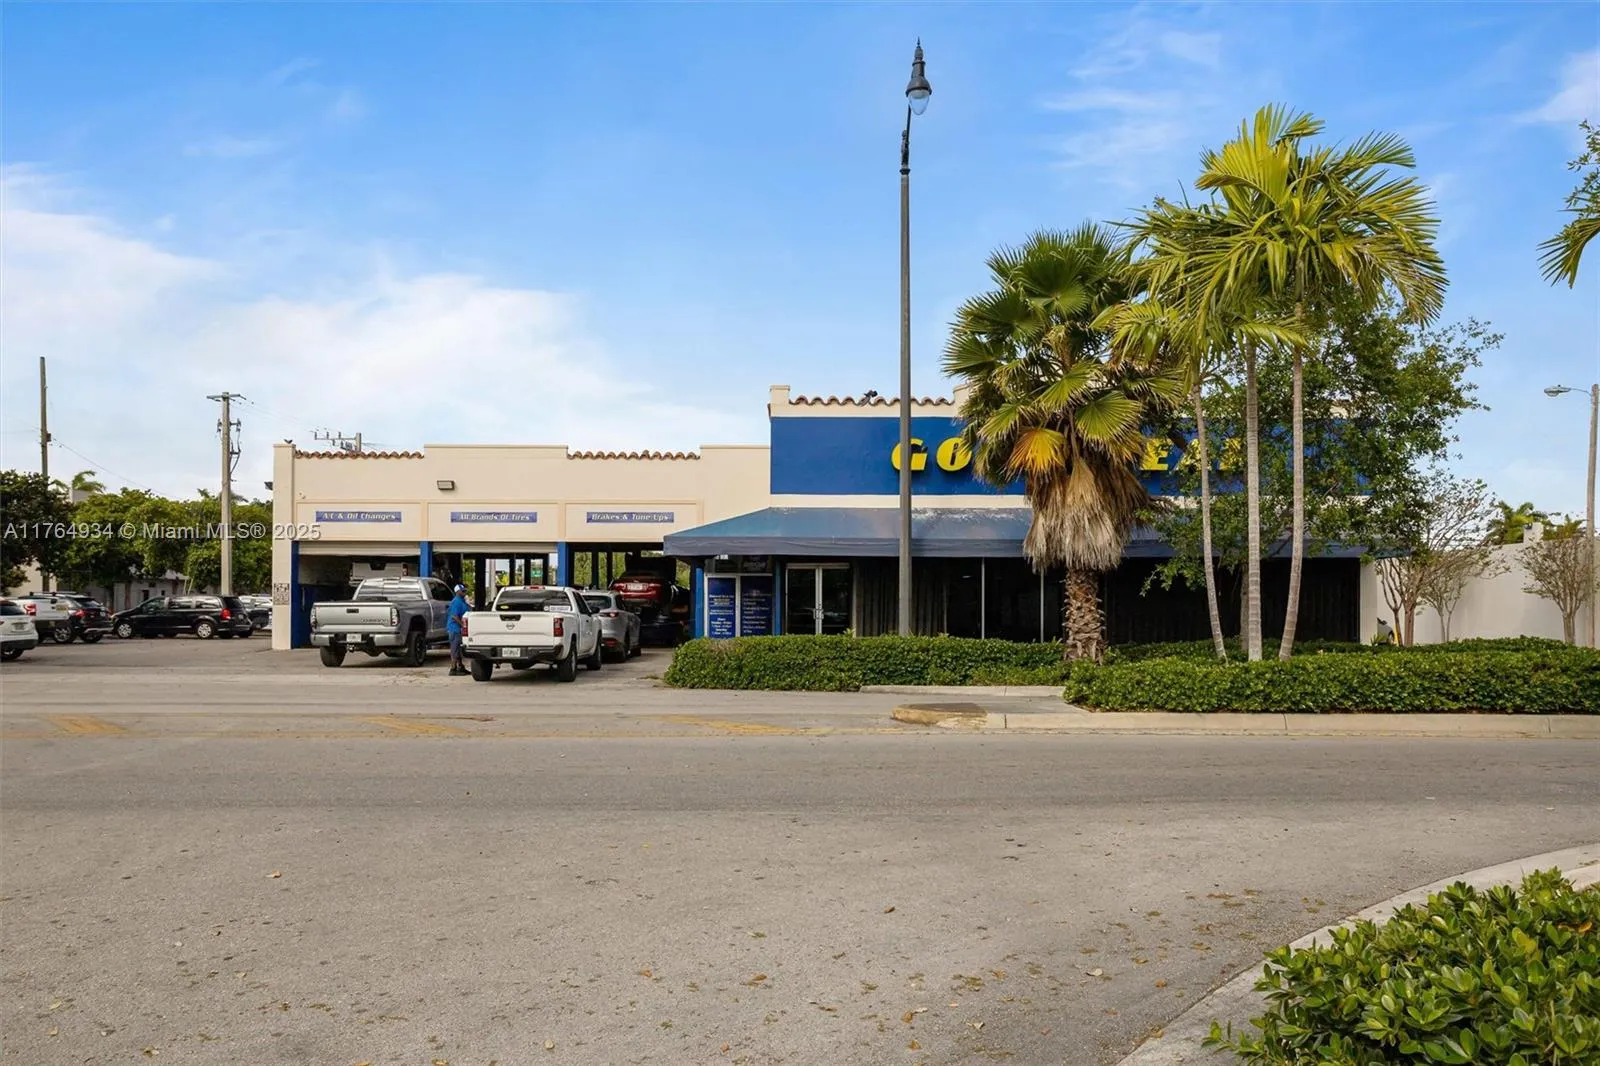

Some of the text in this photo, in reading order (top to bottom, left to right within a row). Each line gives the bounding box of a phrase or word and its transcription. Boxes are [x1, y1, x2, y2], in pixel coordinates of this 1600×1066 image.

[347, 512, 358, 520] Oil
[360, 512, 396, 521] Changes
[471, 513, 498, 521] Brands
[511, 513, 530, 521] Tires
[591, 513, 620, 521] Brakes
[622, 513, 628, 521] &
